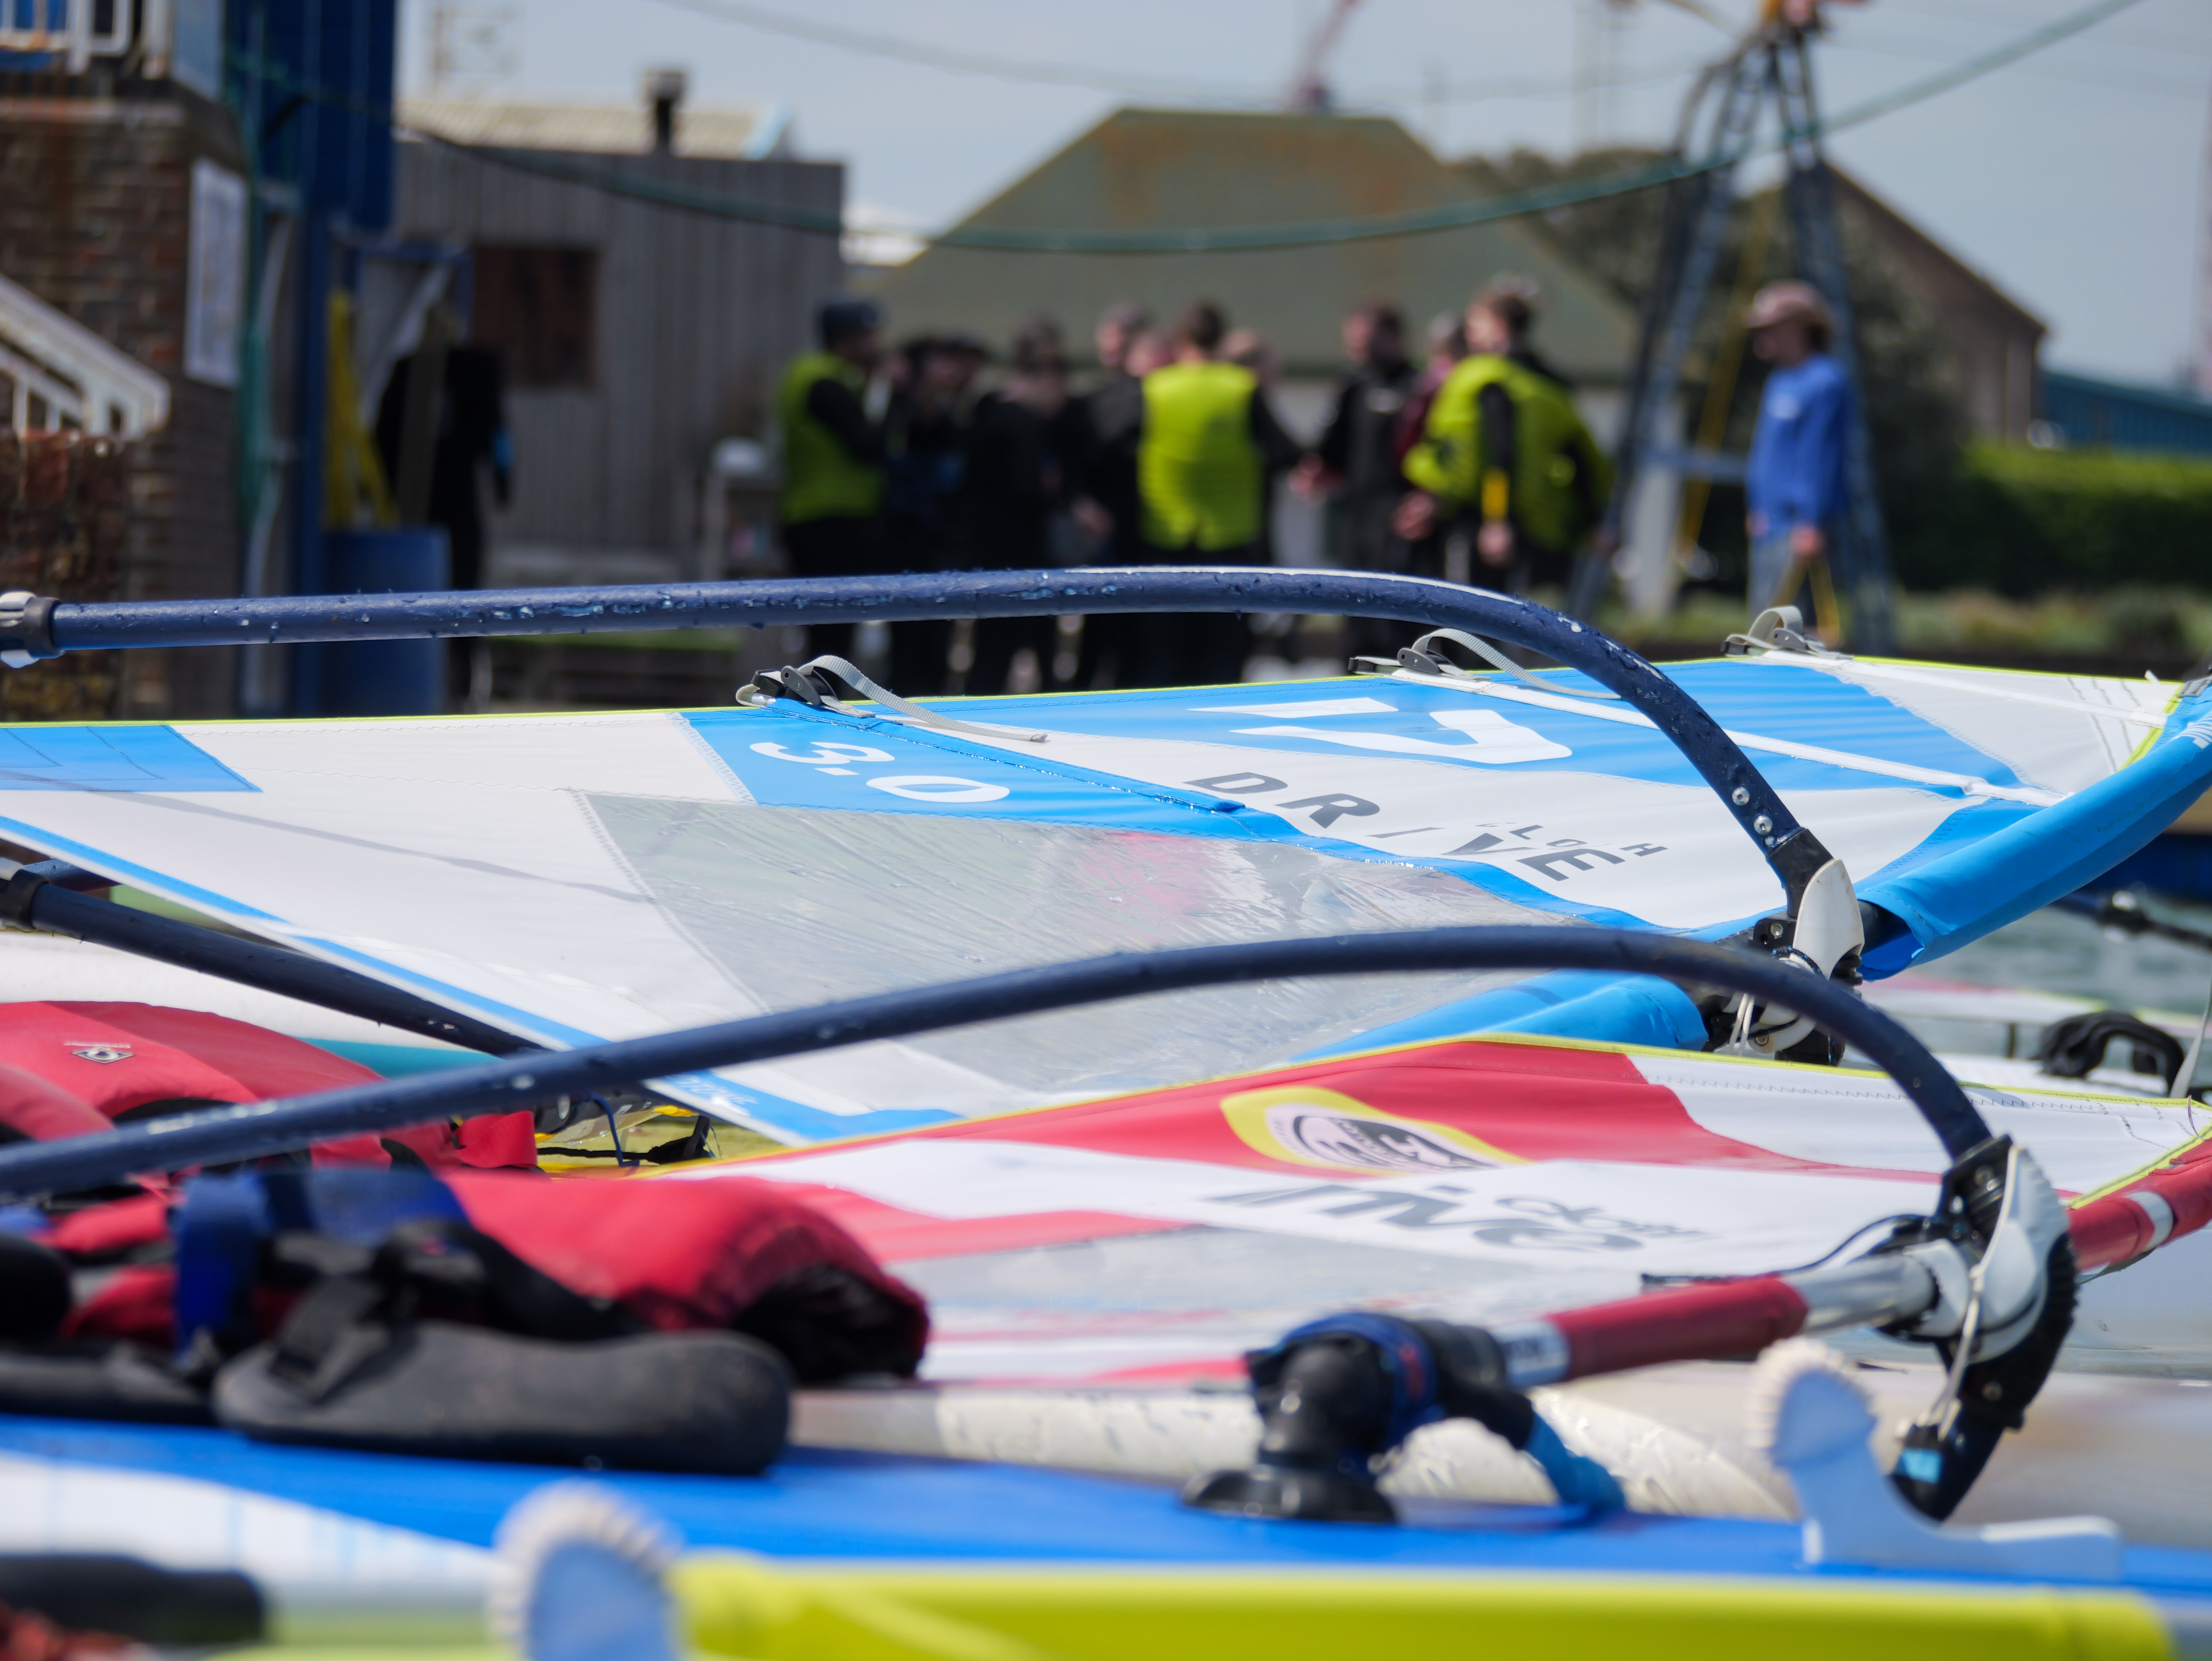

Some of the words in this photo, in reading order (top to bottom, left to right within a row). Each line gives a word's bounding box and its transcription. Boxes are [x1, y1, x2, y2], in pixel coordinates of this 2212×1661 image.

[750, 741, 1010, 803] 3.0
[1182, 772, 1626, 881] DRIVE
[1475, 822, 1669, 857] CLOH
